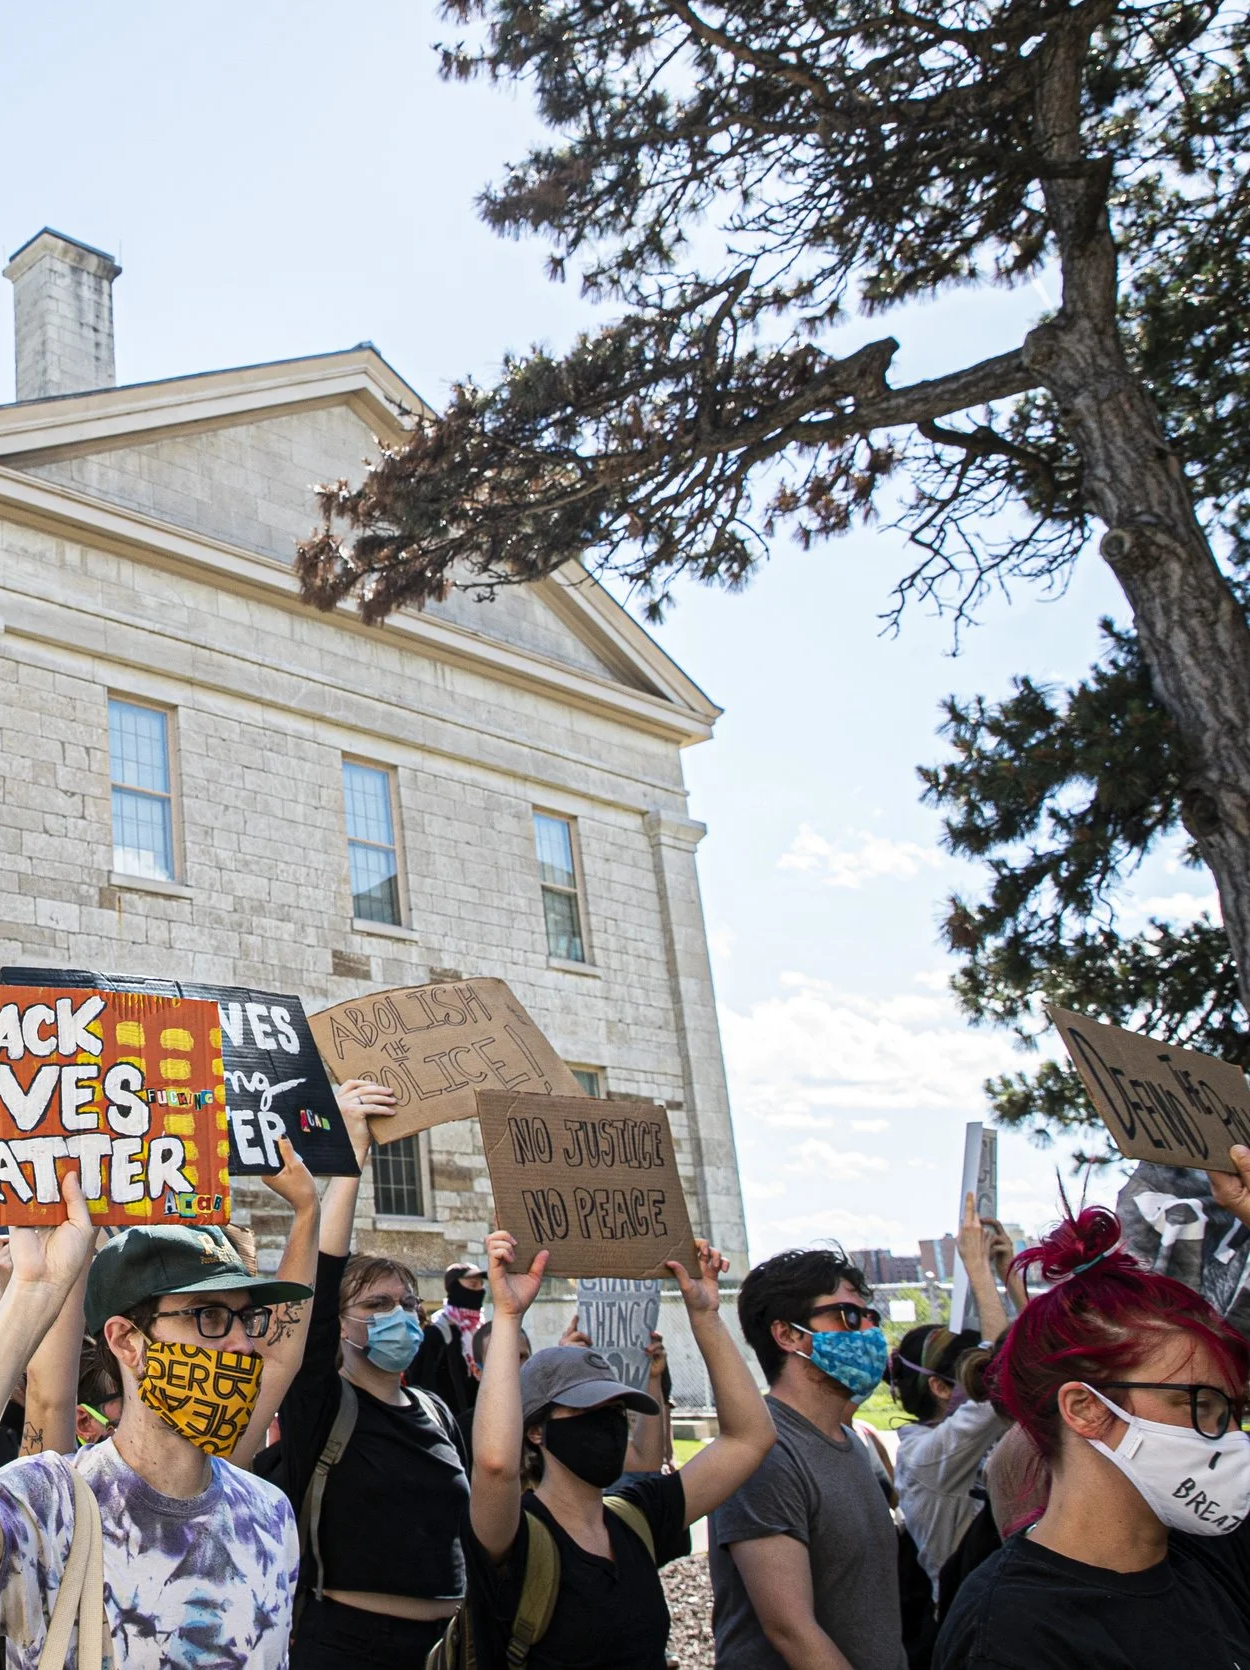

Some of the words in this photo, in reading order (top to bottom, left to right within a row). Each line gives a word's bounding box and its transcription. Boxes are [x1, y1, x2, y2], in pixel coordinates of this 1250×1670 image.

[330, 983, 492, 1060] ABOLISH
[381, 1036, 410, 1061] THE
[508, 1116, 553, 1167] NO
[564, 1118, 664, 1168] JUSTICE
[522, 1188, 569, 1243] NO
[574, 1187, 668, 1240] PEACE
[1208, 1451, 1222, 1470] I
